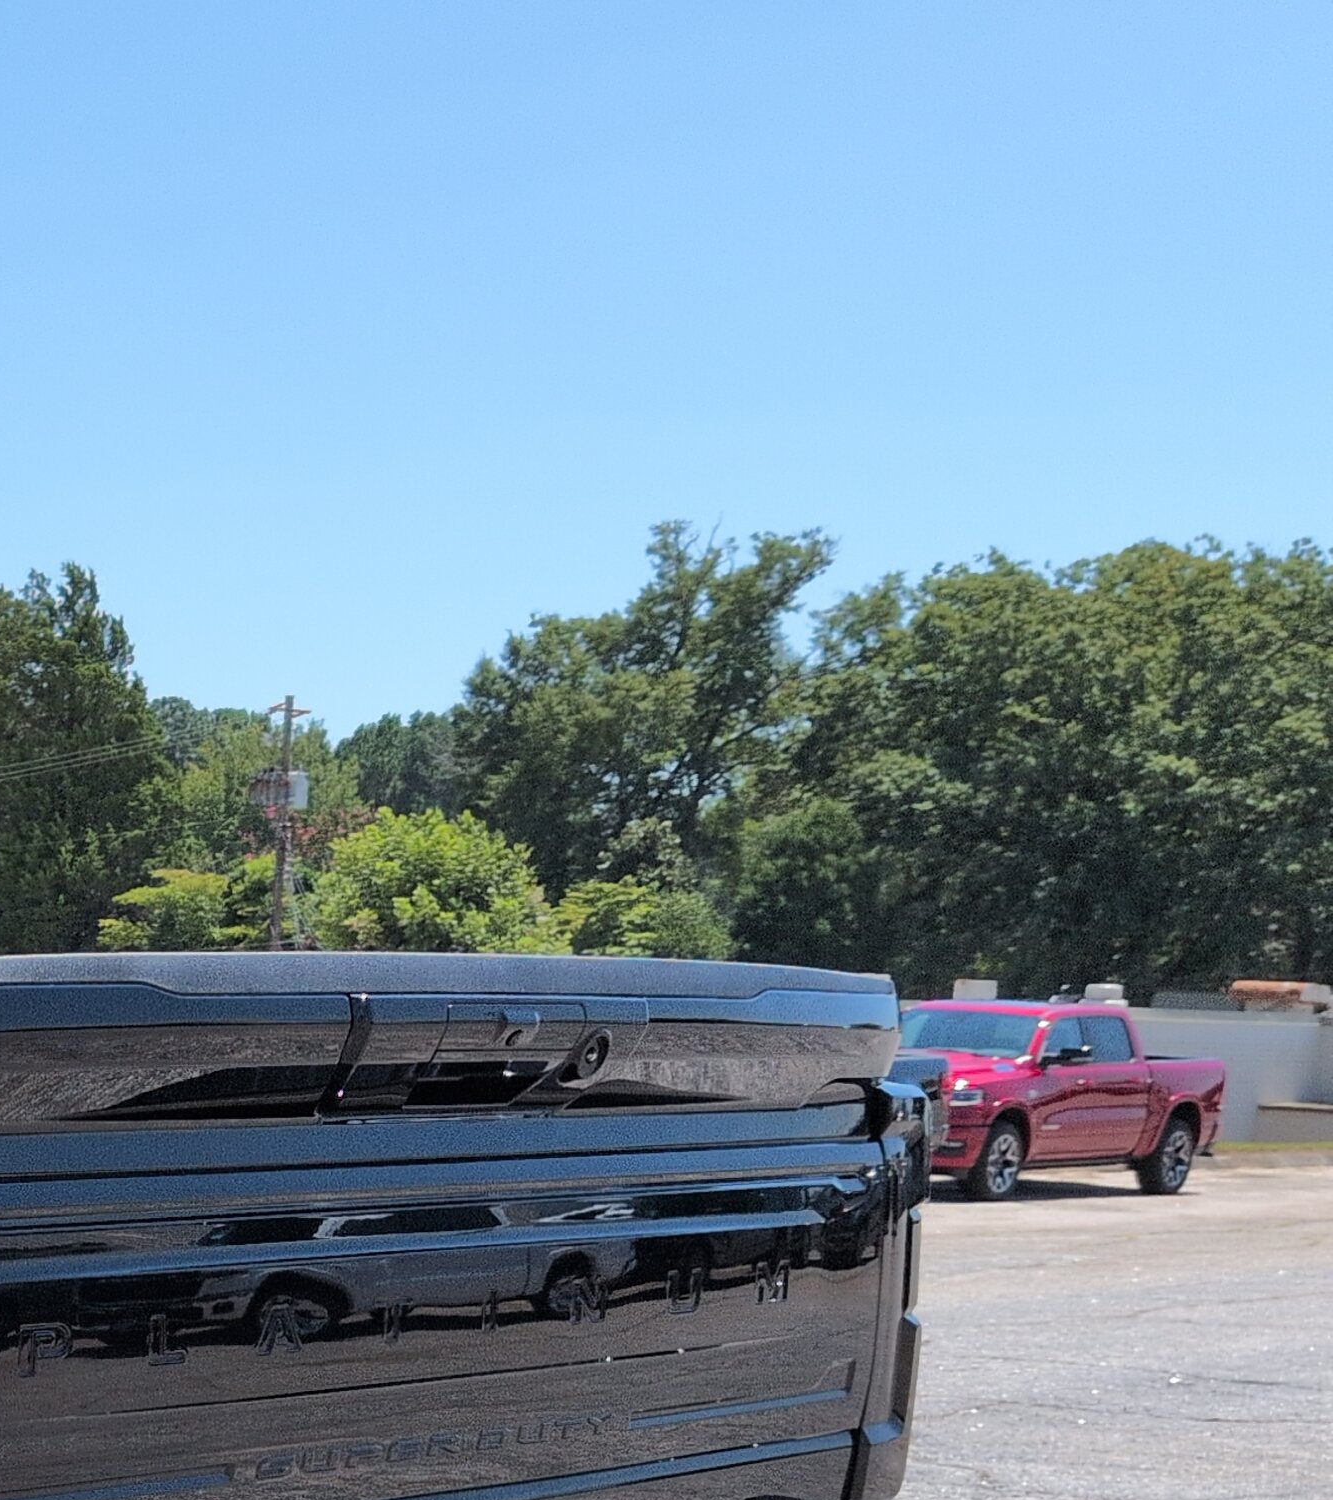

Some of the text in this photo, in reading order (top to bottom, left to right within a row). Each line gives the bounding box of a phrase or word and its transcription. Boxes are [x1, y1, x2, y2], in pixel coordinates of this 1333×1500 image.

[17, 1257, 791, 1377] PLATINUM
[254, 1412, 615, 1481] SUPER DUTY
